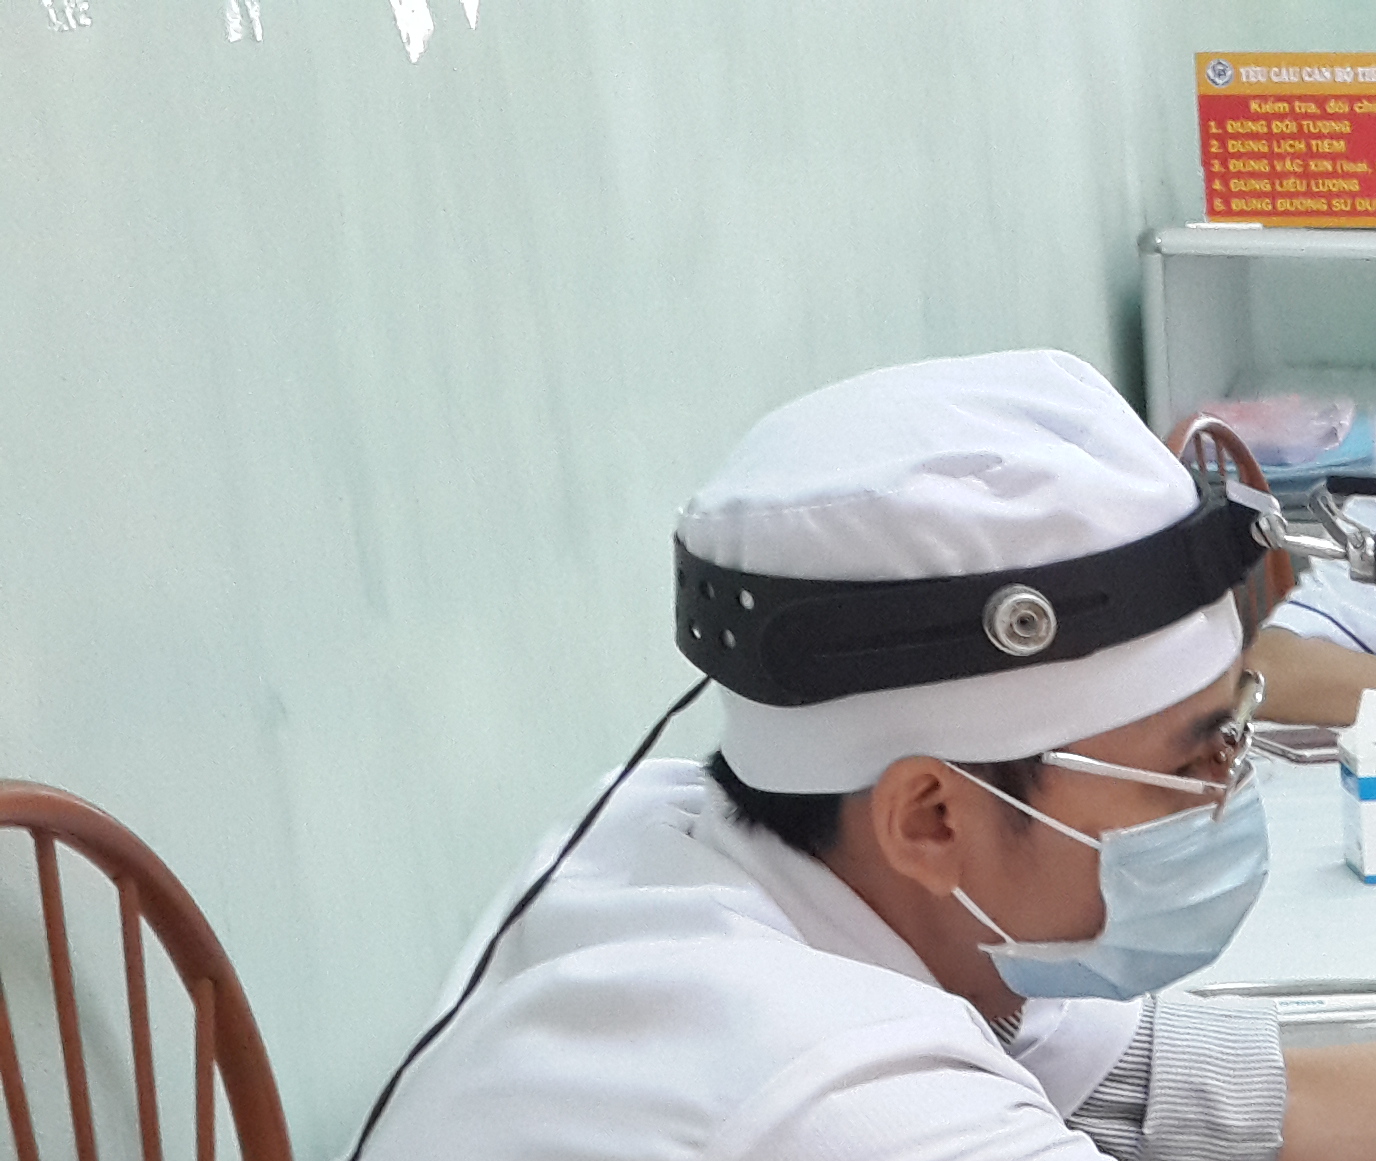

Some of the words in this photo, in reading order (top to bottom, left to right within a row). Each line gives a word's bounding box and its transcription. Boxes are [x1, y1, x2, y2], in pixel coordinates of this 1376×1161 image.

[1208, 121, 1222, 133] 1.
[1209, 140, 1223, 153] 2.
[1211, 160, 1225, 172] 3.
[1212, 179, 1225, 192] 4.
